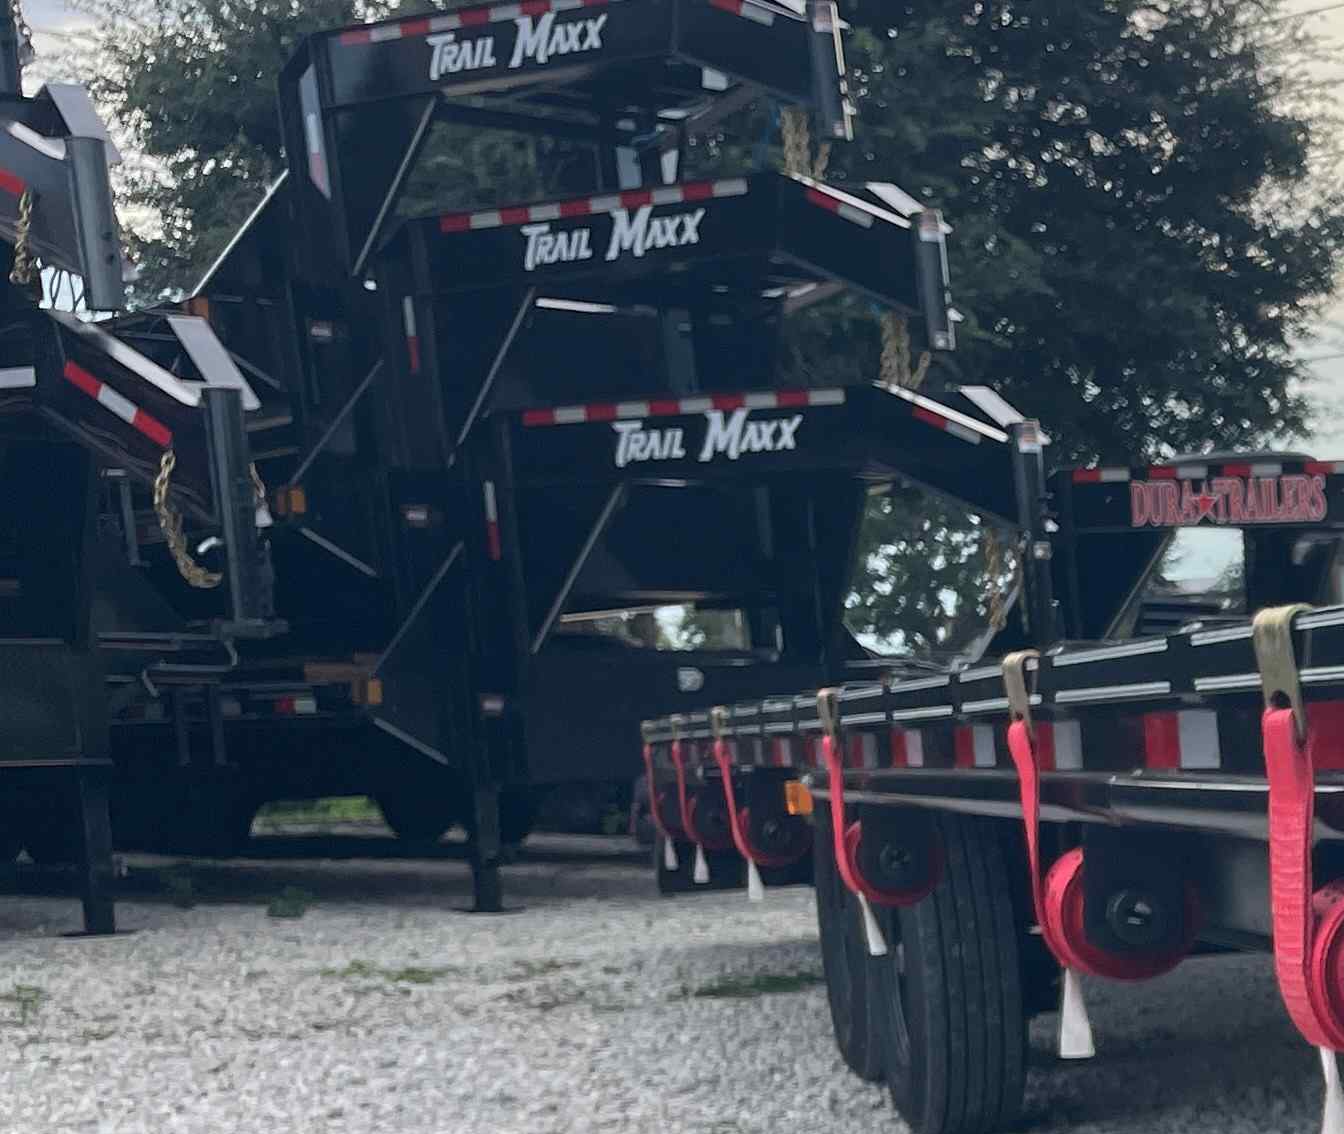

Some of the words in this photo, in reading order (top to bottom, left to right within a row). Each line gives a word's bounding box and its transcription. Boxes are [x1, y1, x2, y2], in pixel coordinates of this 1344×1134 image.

[425, 31, 497, 81] TRAIL
[507, 11, 608, 69] MAXX
[519, 222, 593, 271] TRAIL
[604, 204, 706, 261] MAXX
[610, 420, 687, 468] TRAIL
[698, 407, 804, 462] MAXX
[1210, 474, 1328, 525] TRAILERS
